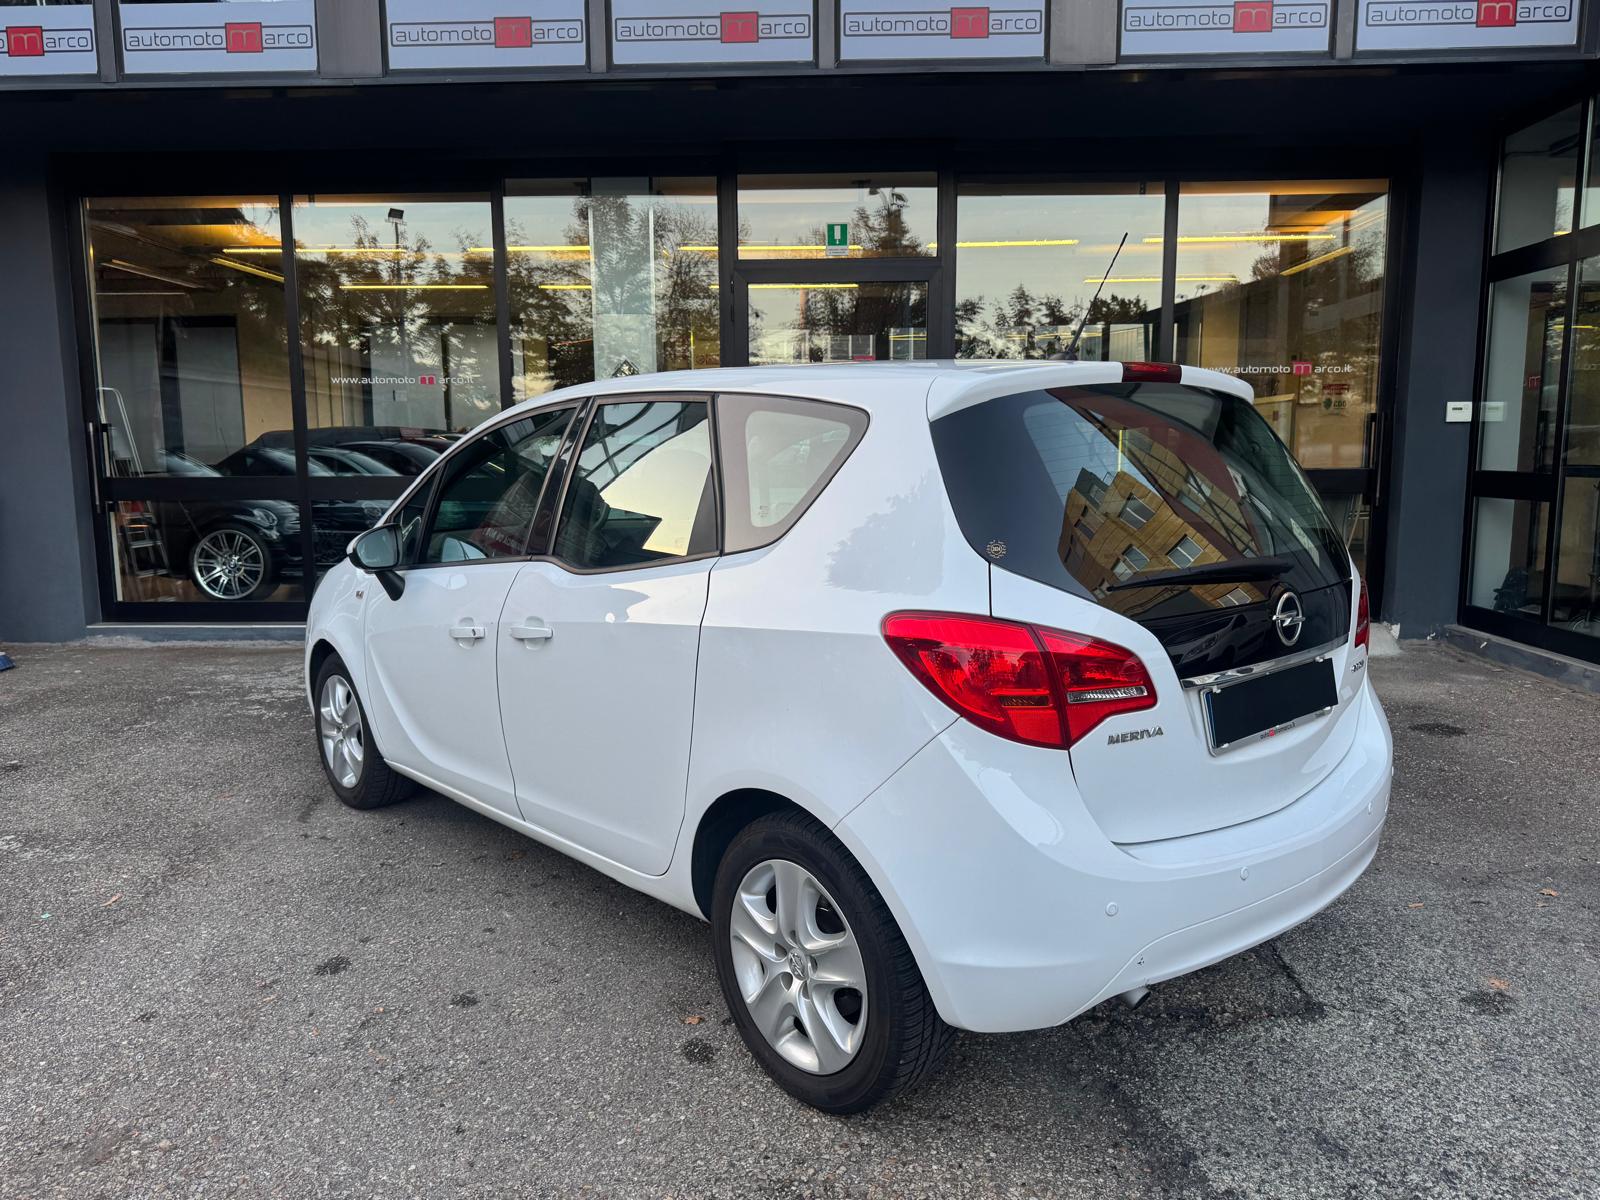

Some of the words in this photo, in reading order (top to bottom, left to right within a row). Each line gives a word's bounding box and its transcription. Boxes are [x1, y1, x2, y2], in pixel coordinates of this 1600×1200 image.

[1129, 9, 1231, 28] automoto
[1371, 4, 1474, 22] automoto
[619, 20, 718, 38] automoto
[848, 14, 949, 33] automoto
[129, 31, 223, 47] automoto
[394, 26, 493, 43] automoto
[1107, 726, 1164, 745] MERIVA
